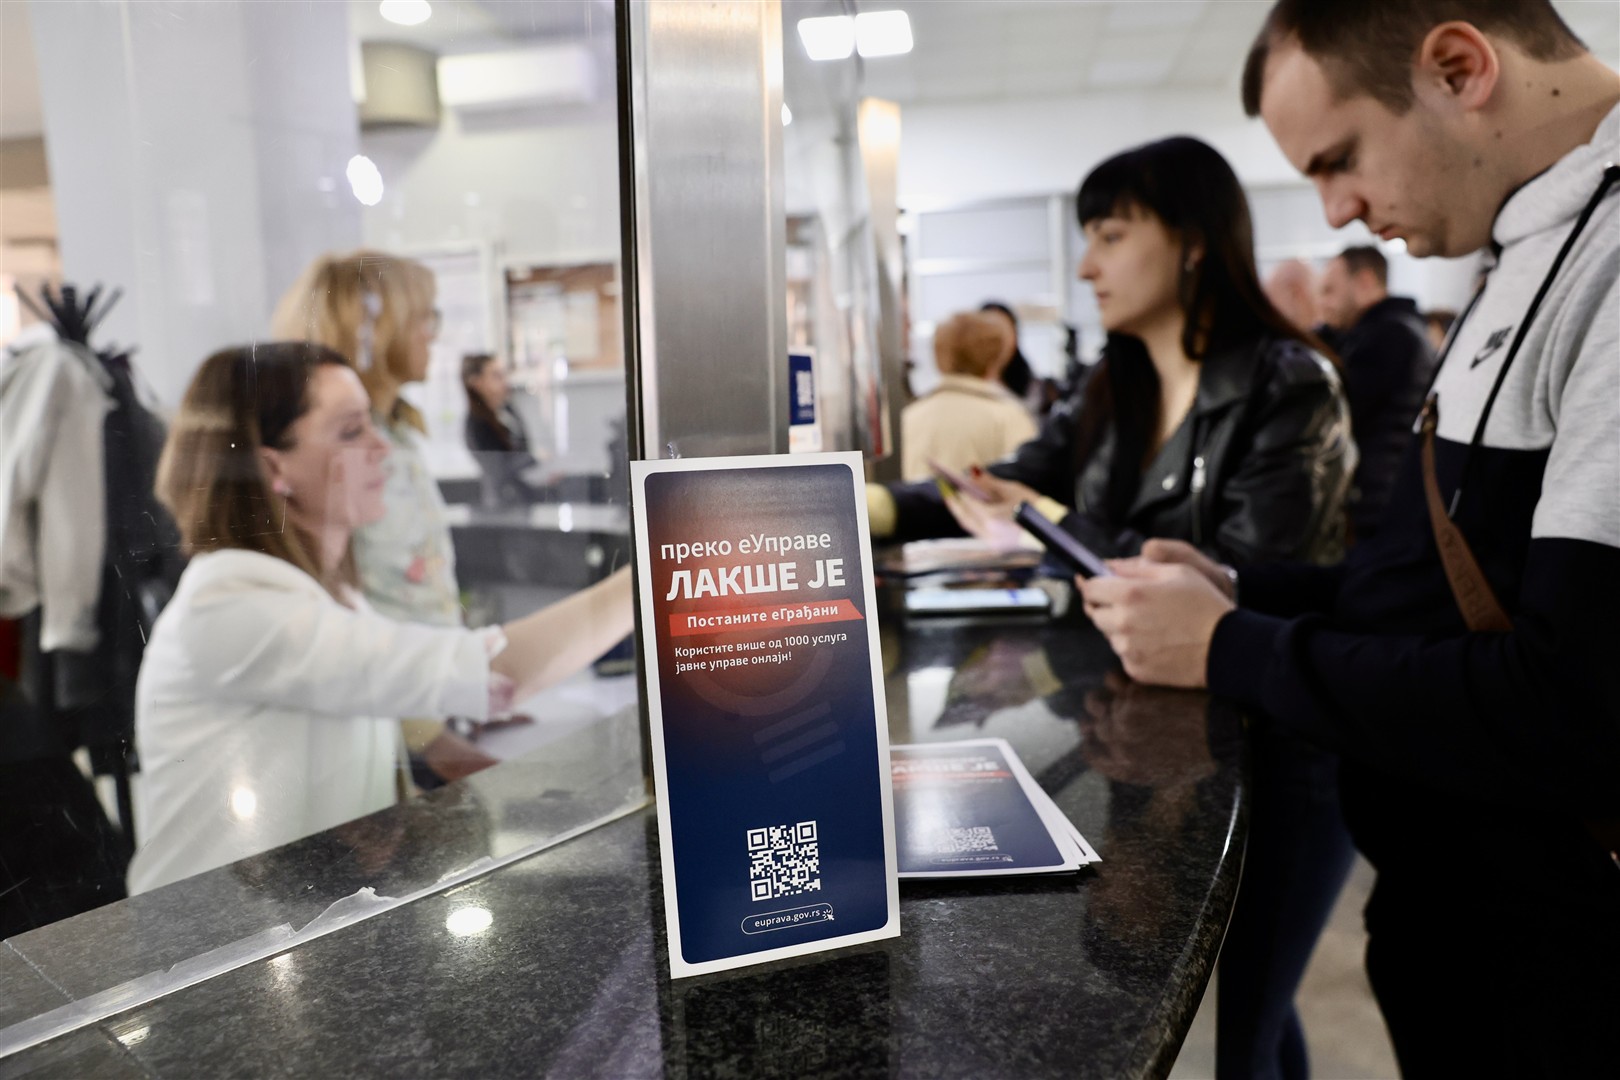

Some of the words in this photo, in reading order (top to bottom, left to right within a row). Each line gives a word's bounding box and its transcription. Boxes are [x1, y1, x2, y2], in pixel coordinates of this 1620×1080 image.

[661, 539, 732, 564] преко
[738, 533, 832, 556] еУправе
[666, 562, 799, 601] ЛАКШЕ
[807, 558, 846, 589] ЈЕ
[687, 612, 767, 628] Постаните
[771, 605, 839, 625] еГрађани
[675, 643, 734, 658] Користите
[736, 641, 766, 652] више
[768, 639, 783, 650] од
[784, 635, 809, 648] 1000
[812, 633, 847, 647] услуга
[675, 660, 707, 674] јавне
[709, 657, 749, 672] управе
[751, 651, 792, 665] онлајн!
[754, 909, 820, 927] euprava.gov.rs
